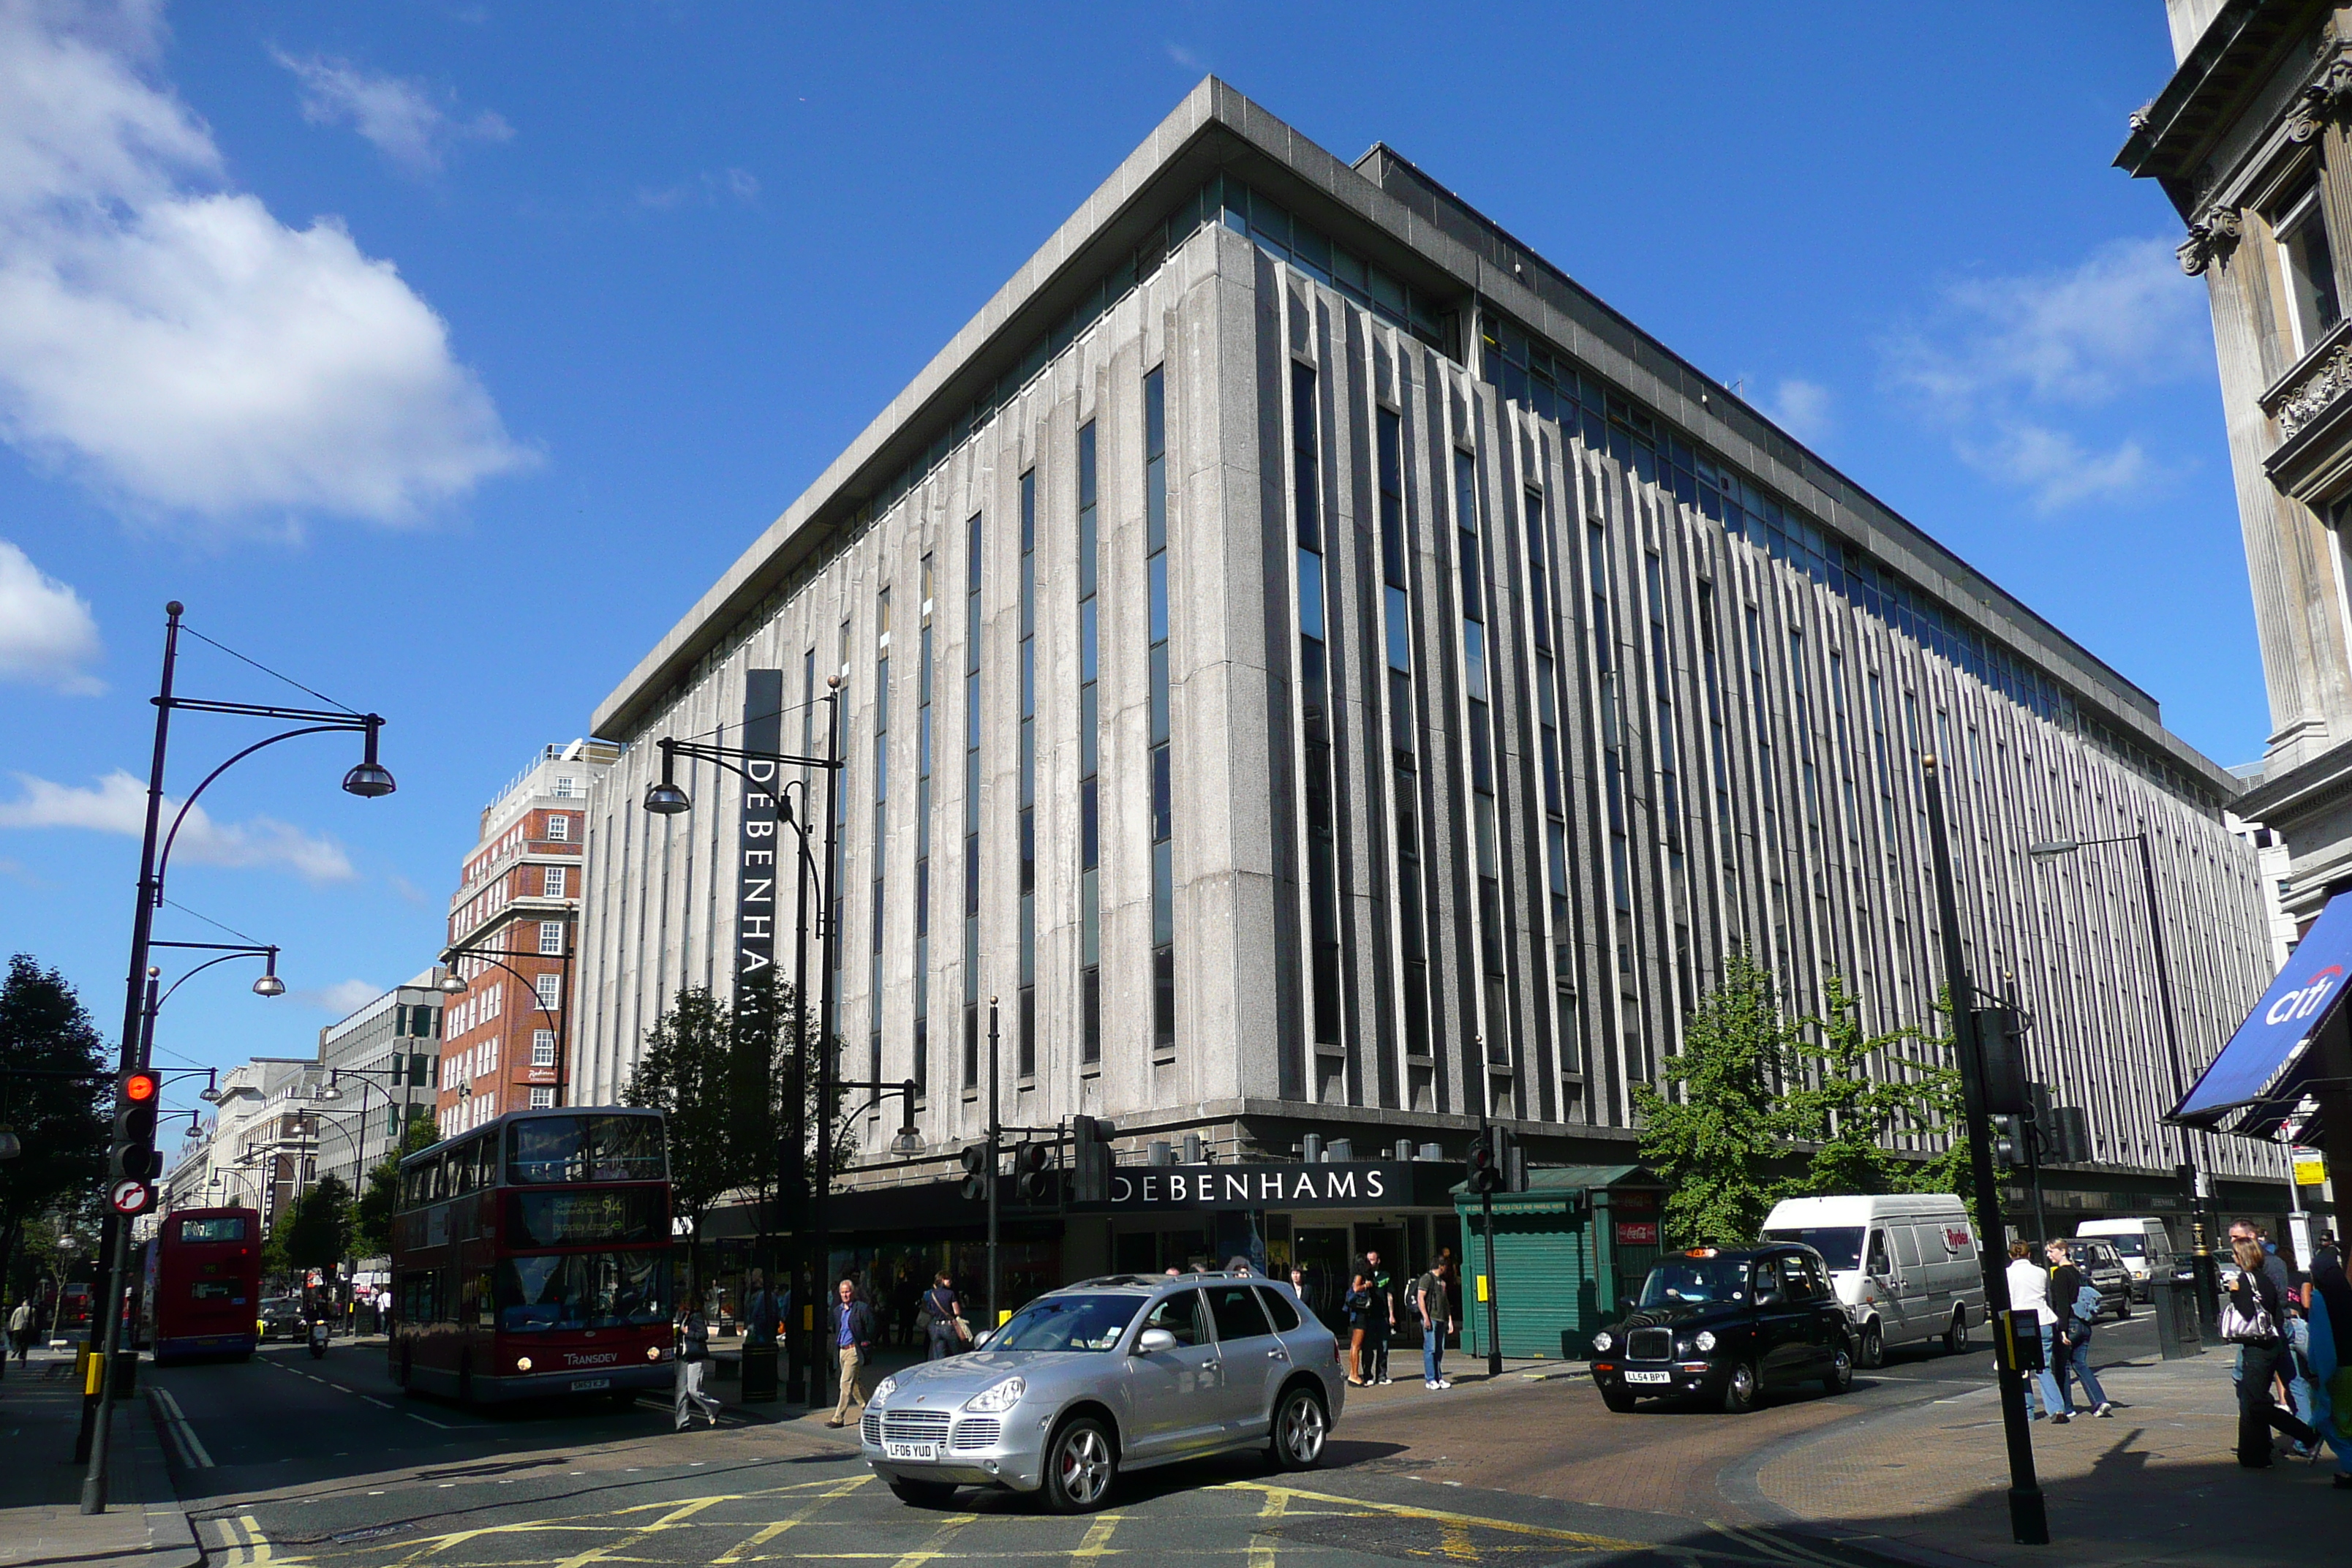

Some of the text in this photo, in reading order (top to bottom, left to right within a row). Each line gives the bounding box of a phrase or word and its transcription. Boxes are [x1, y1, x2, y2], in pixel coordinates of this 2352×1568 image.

[2266, 976, 2334, 1026] citi
[1111, 1170, 1384, 1202] DEBENHAMS
[602, 1199, 622, 1215] 94
[1946, 1228, 1969, 1249] Ryder
[563, 1352, 617, 1365] TRANSDEV
[1627, 1372, 1666, 1382] LL54 BPY
[890, 1444, 931, 1457] LF06 YUD
